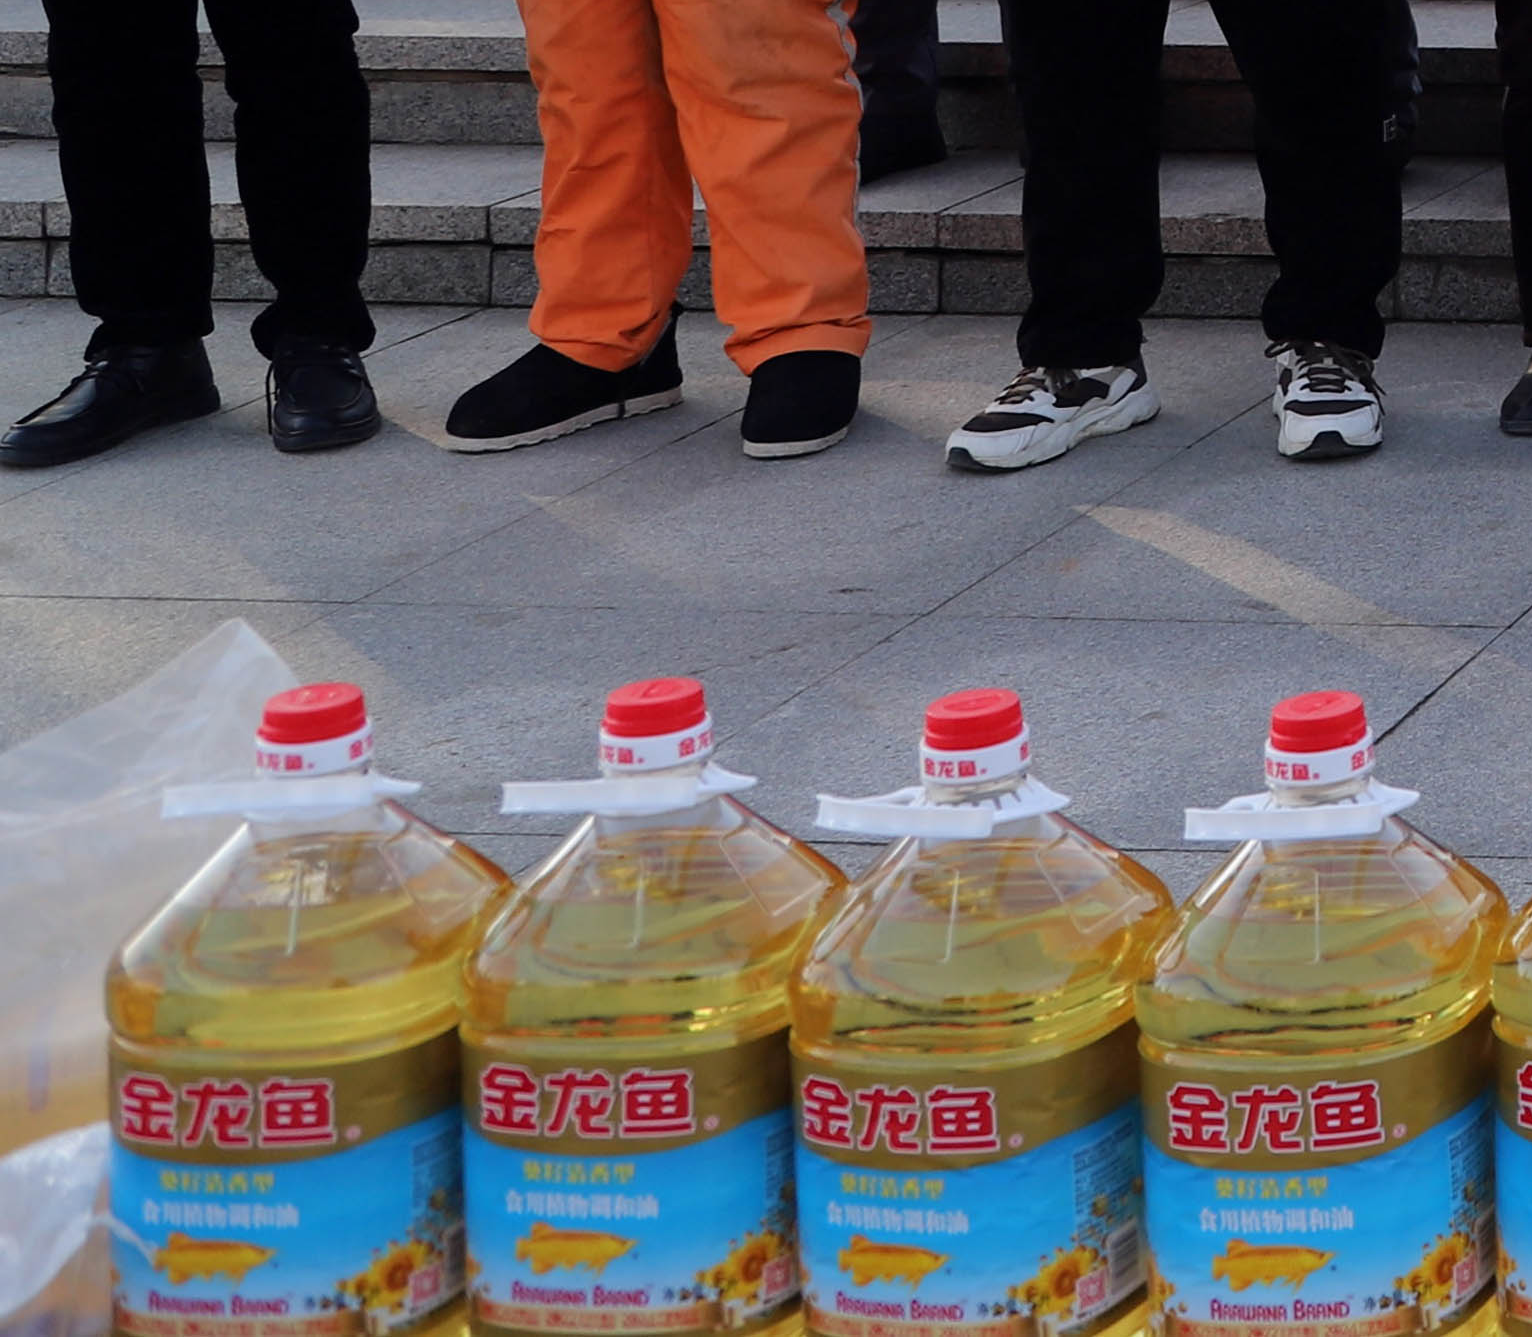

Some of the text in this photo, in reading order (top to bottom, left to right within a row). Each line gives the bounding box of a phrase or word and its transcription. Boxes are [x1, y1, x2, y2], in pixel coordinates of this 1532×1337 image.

[119, 1074, 336, 1148] 金龙鱼
[480, 1064, 695, 1137] 金龙鱼
[799, 1076, 1000, 1154] 金龙鱼
[1166, 1080, 1385, 1153] 金龙鱼
